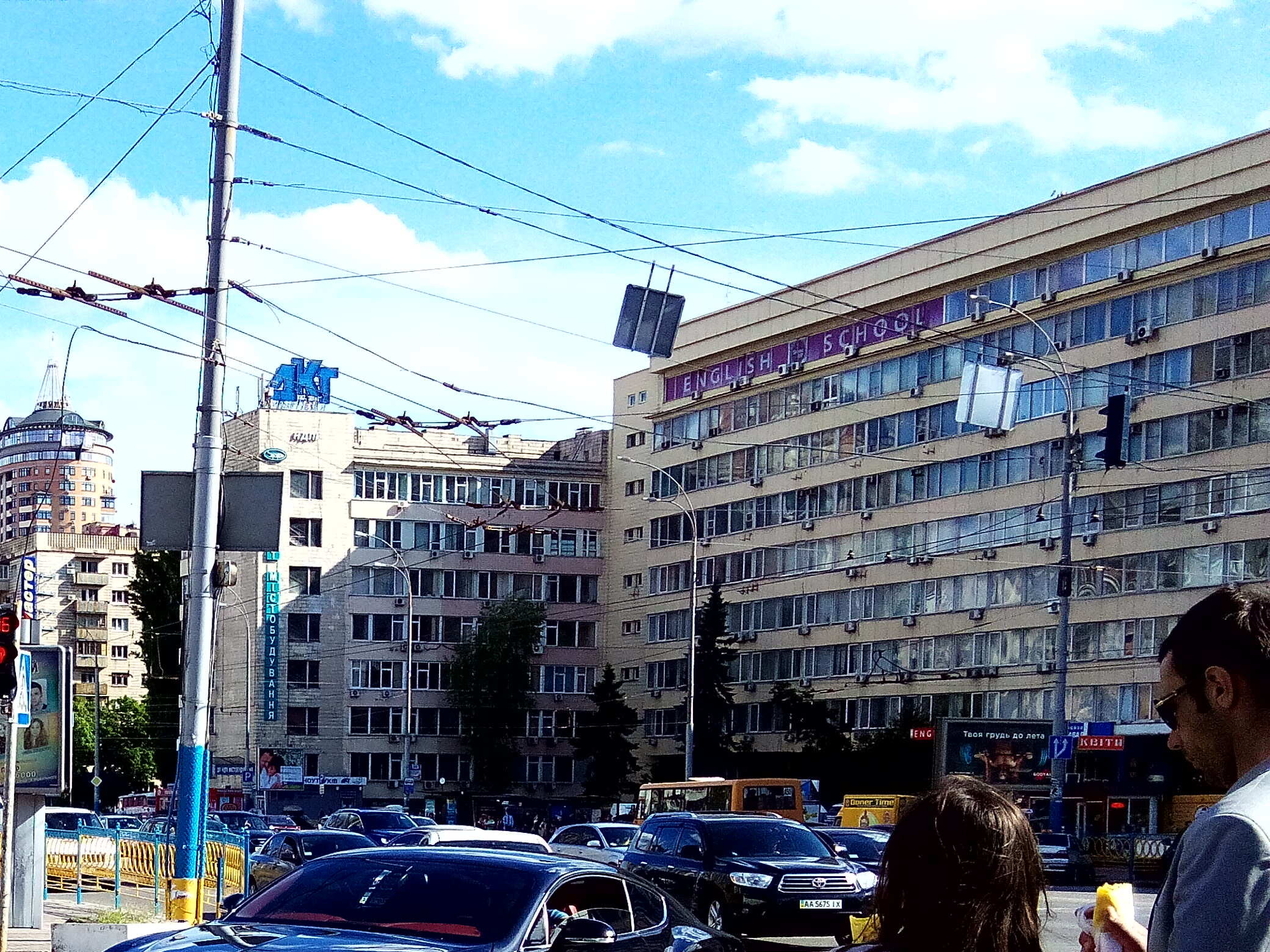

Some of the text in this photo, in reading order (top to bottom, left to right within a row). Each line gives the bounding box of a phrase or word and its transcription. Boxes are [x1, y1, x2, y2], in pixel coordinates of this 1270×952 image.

[683, 308, 926, 393] ENGLISH SCHOOL
[267, 571, 278, 720] МІСТОБУДУВАННЯ
[963, 730, 983, 738] Твоя
[985, 732, 1010, 740] грудь
[1080, 738, 1123, 747] КВІТИ
[804, 900, 814, 908] AA
